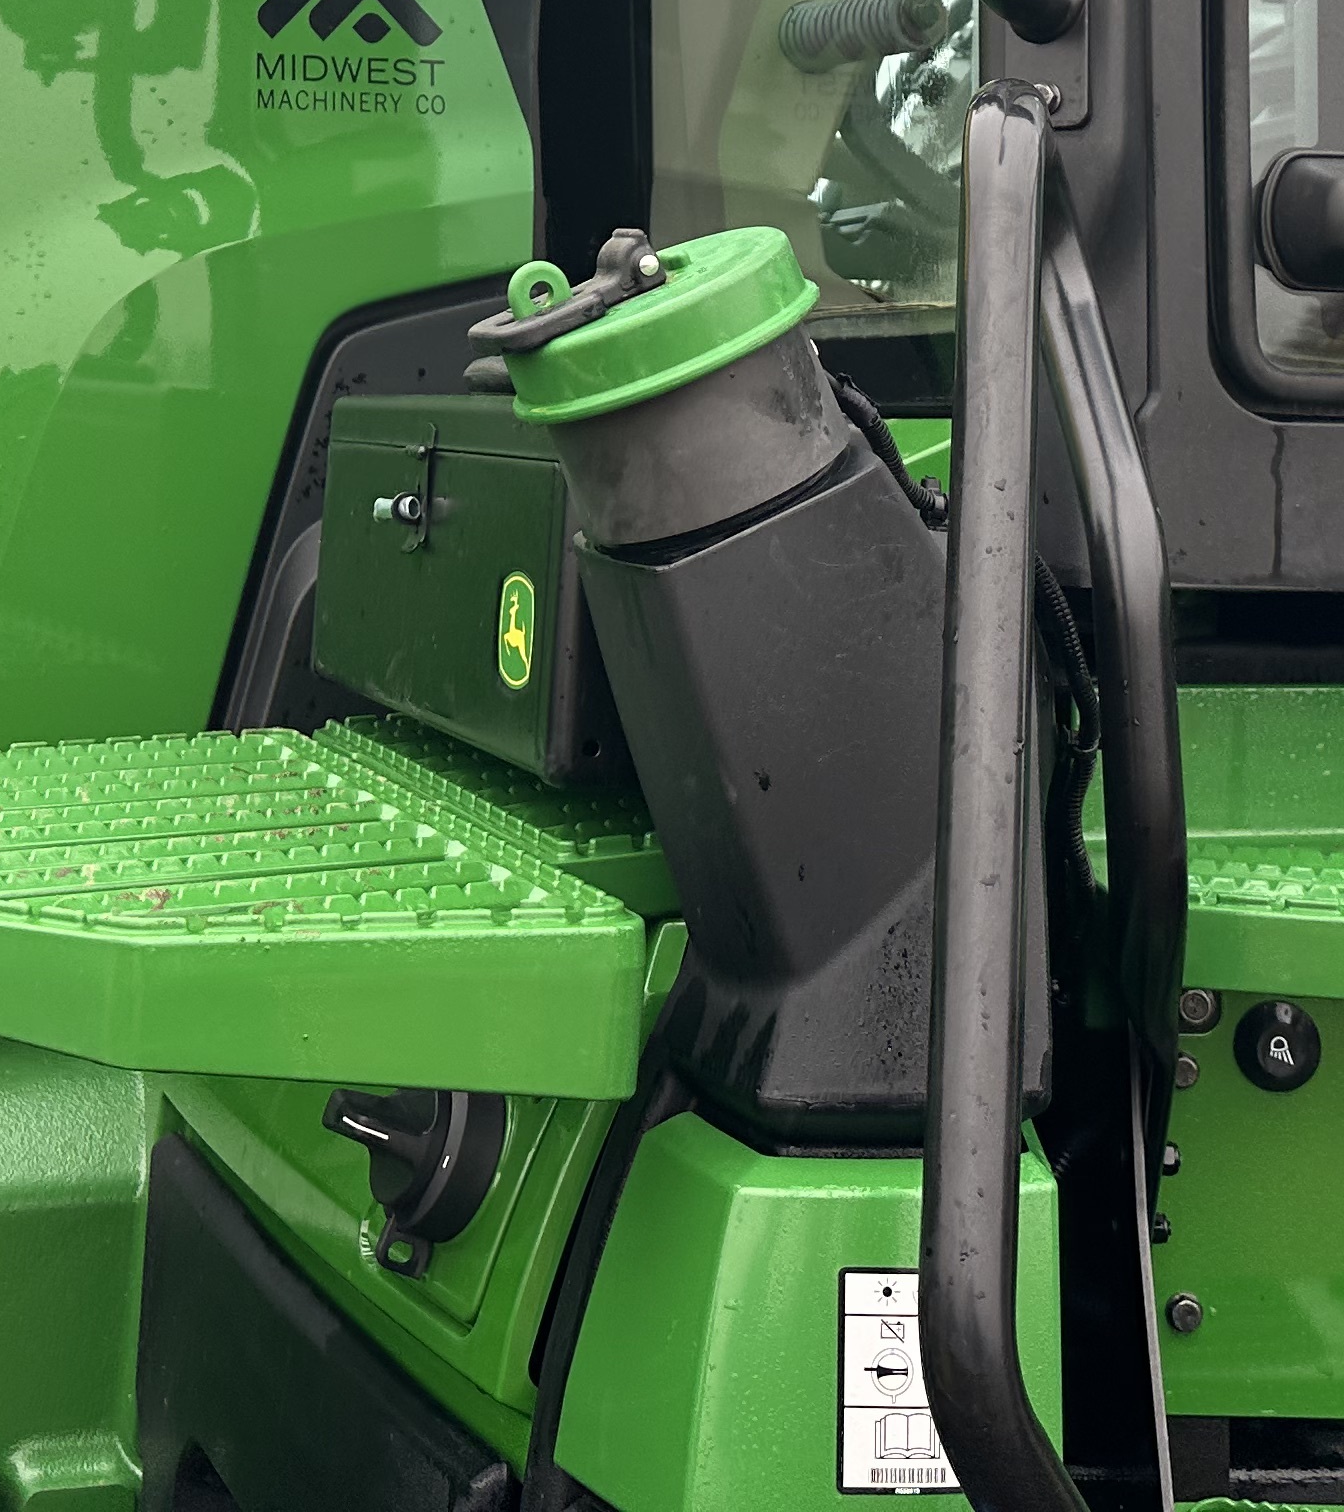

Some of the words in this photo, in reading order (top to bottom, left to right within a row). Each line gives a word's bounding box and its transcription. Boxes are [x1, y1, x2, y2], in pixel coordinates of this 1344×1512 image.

[256, 52, 446, 87] MIDWEST
[256, 88, 403, 113] MACHINERY
[416, 93, 446, 115] CO
